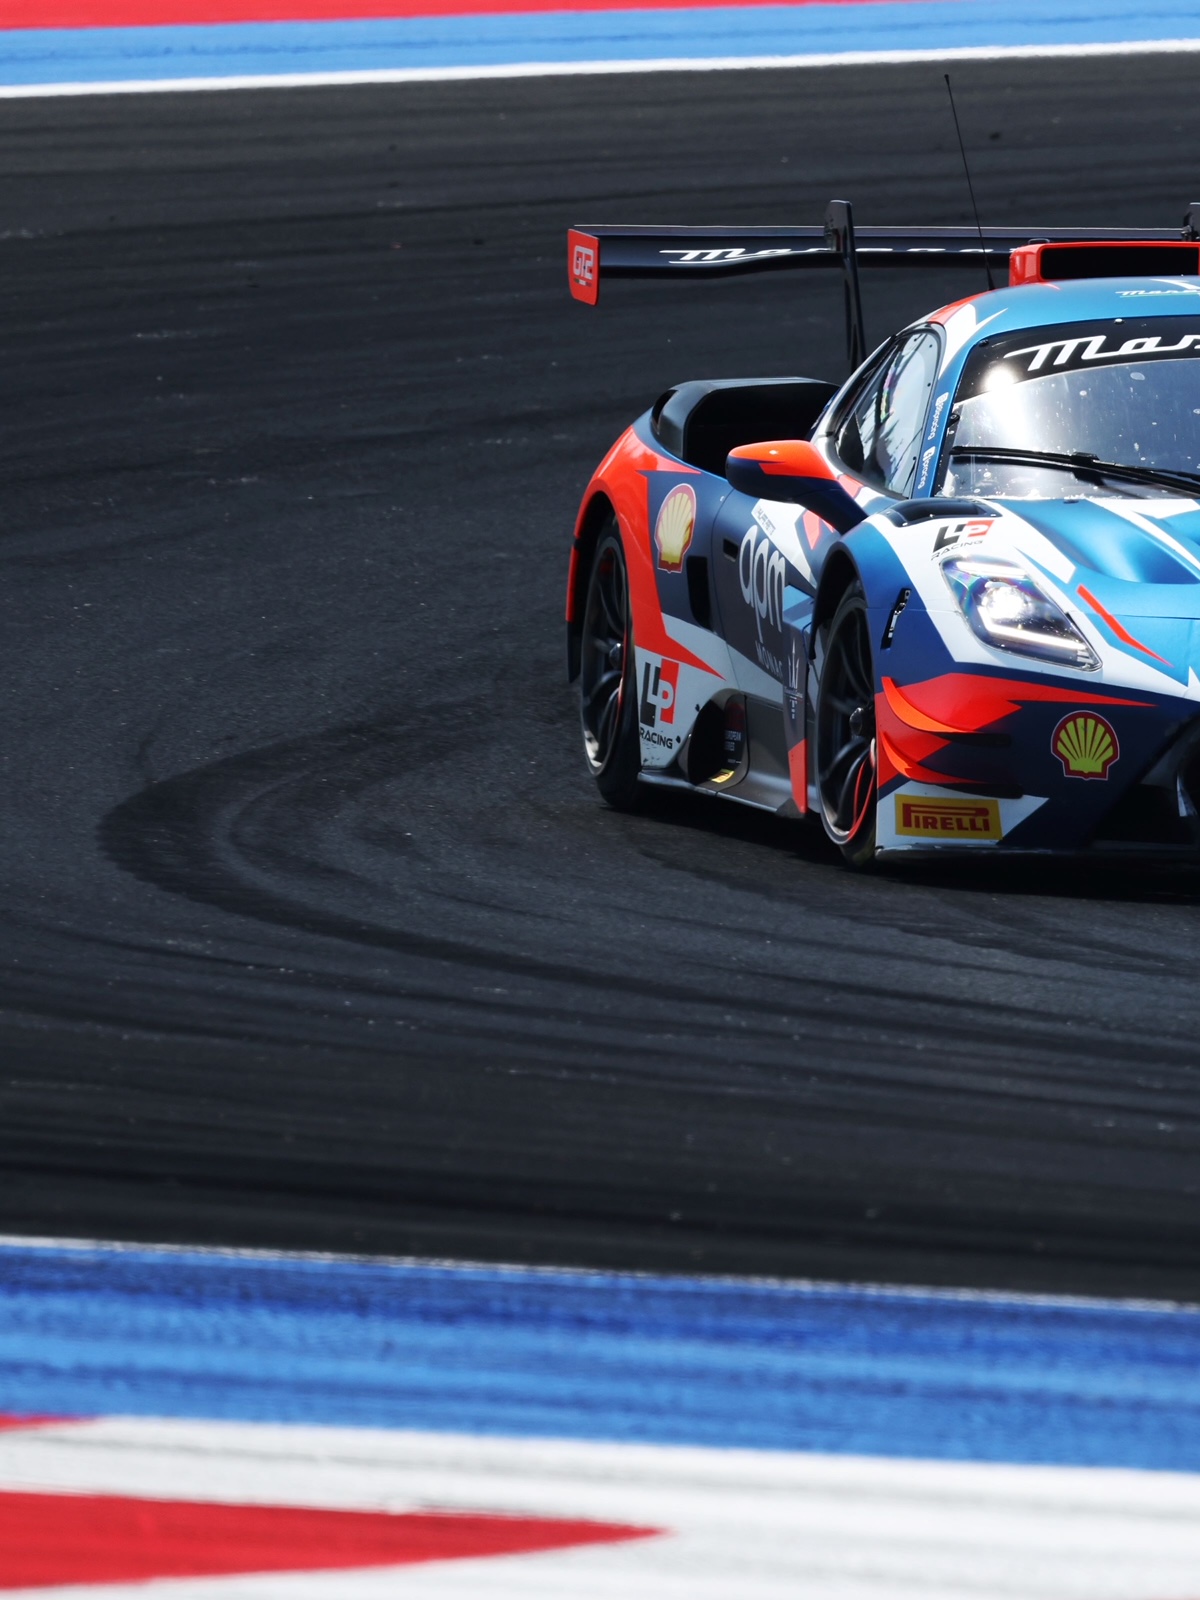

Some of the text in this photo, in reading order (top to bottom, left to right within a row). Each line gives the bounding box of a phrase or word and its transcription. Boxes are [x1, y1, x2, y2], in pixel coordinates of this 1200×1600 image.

[931, 540, 983, 561] RACING
[739, 524, 786, 643] apm
[639, 727, 673, 750] RACING
[902, 803, 990, 832] PIRELLI
